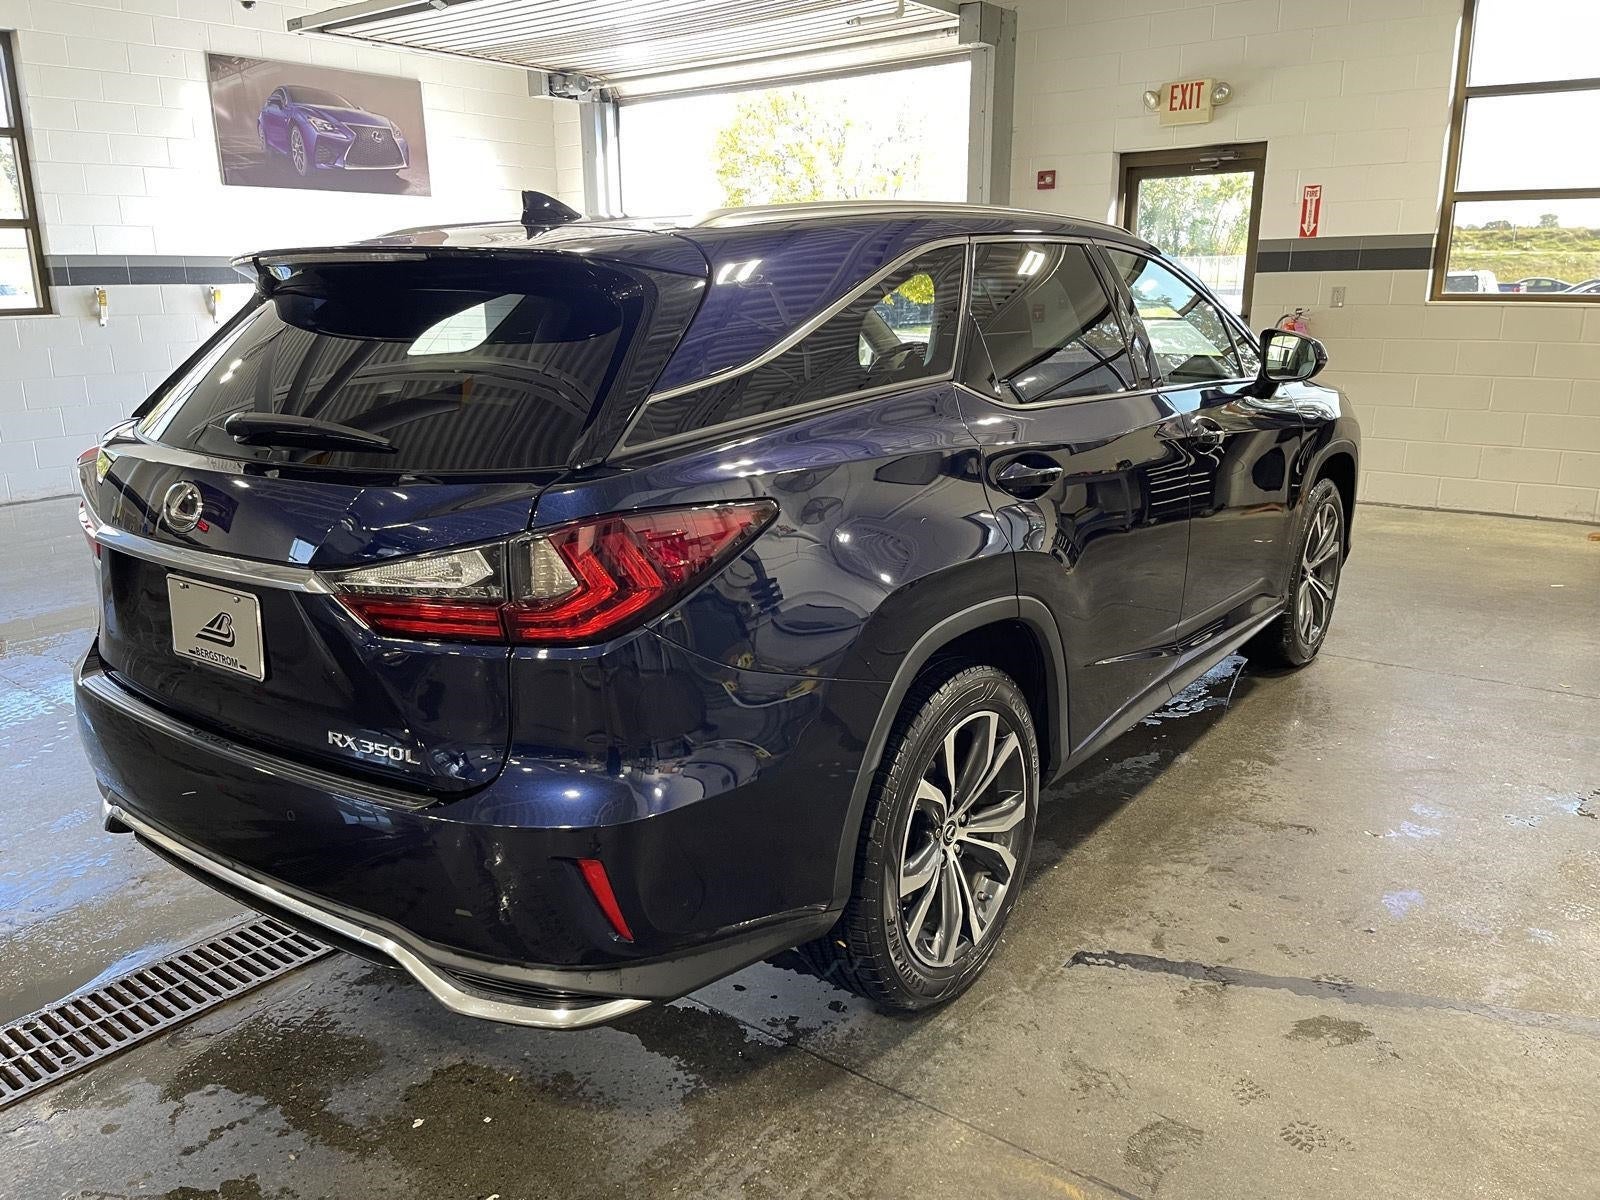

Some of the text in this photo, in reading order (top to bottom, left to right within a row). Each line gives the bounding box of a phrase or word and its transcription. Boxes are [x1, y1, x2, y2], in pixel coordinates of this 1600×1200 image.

[1169, 82, 1205, 112] EXIT
[1306, 189, 1319, 198] FIRE
[195, 647, 239, 669] BERGSTROM
[886, 915, 928, 993] ASSURANCE
